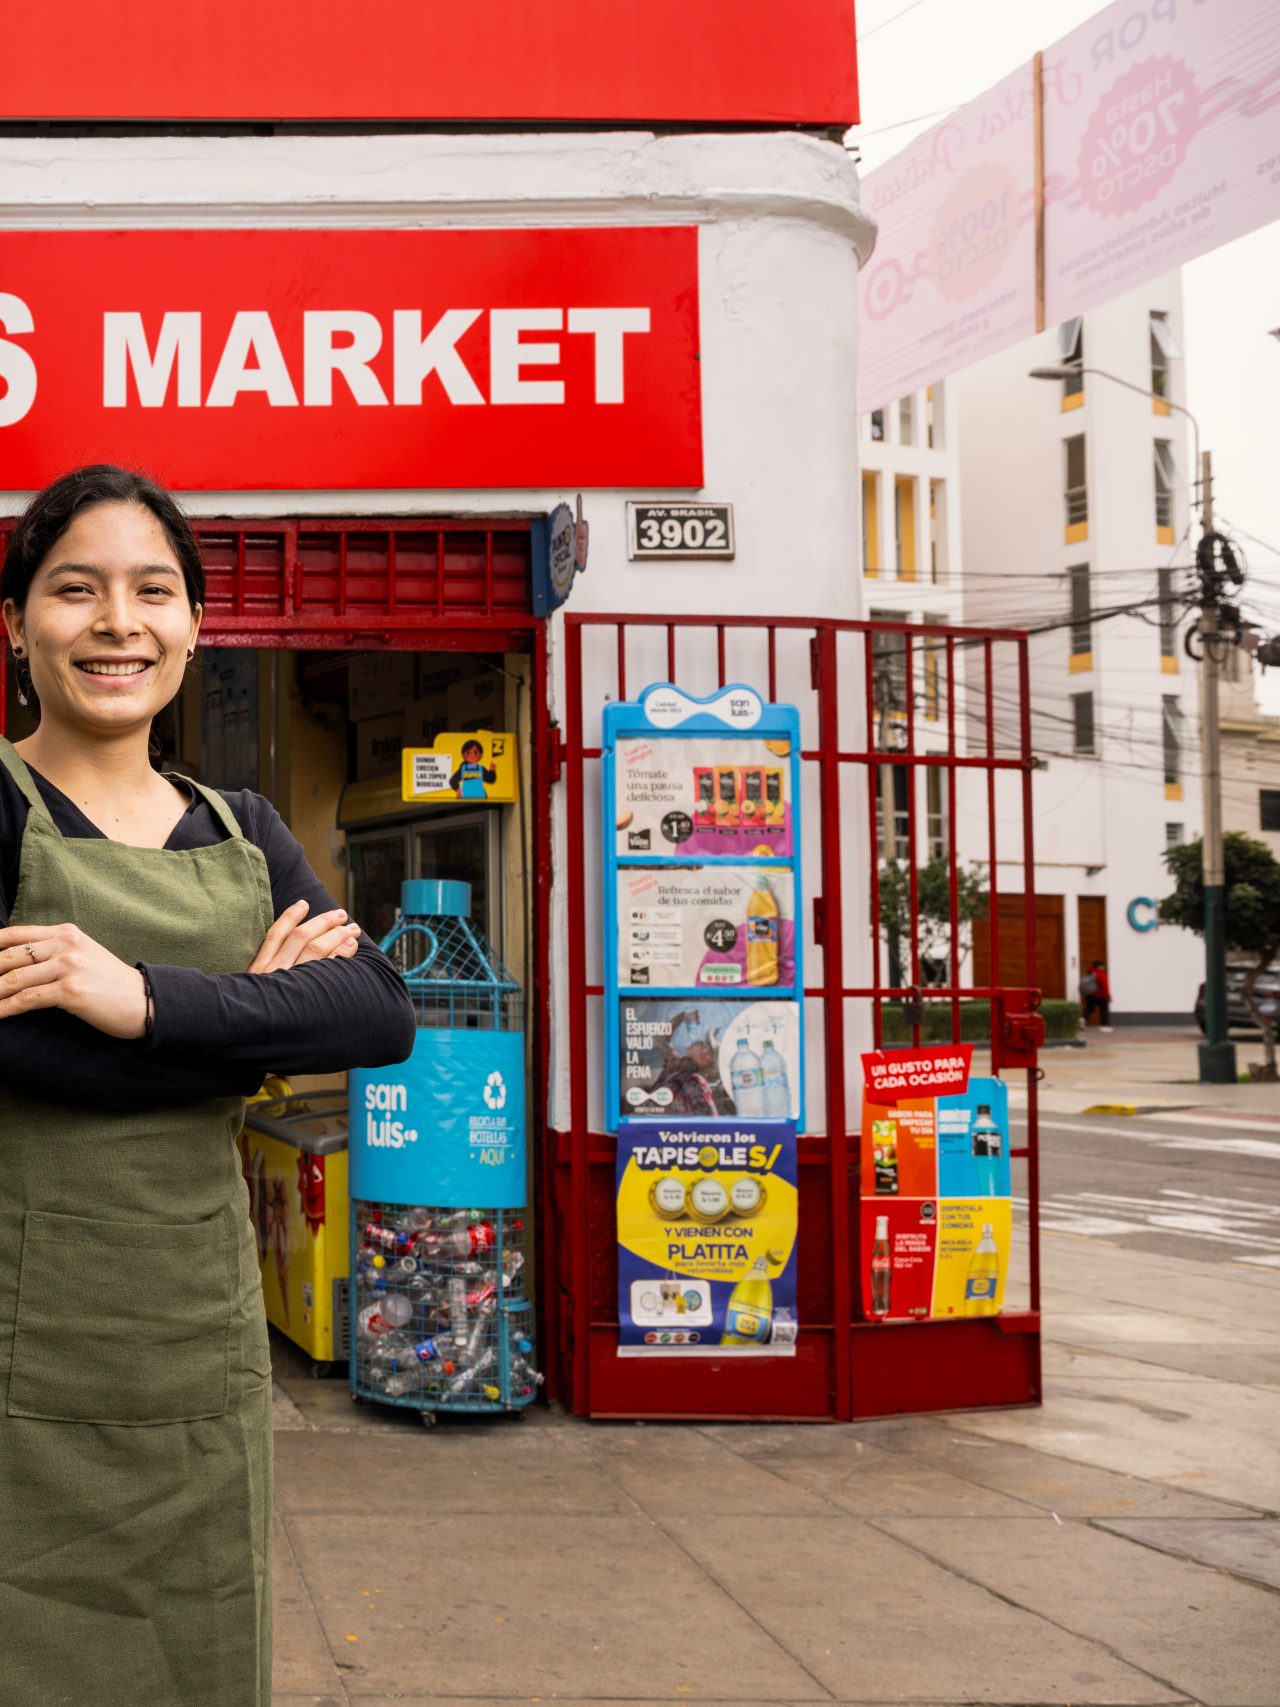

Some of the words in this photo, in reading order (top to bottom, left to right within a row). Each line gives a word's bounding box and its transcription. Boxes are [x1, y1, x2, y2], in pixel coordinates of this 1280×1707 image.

[103, 307, 651, 408] MARKET
[670, 509, 716, 517] BRASIL
[639, 519, 726, 549] 3902
[626, 769, 668, 779] Tómate
[627, 783, 648, 791] una
[650, 783, 683, 792] pausa
[626, 791, 675, 801] deliciosa
[658, 886, 700, 895] Refresca
[703, 886, 713, 895] el
[714, 886, 741, 895] sabor
[658, 896, 671, 905] de
[673, 897, 688, 905] tus
[691, 896, 733, 905] comidas
[626, 1008, 638, 1021] EL
[626, 1022, 672, 1036] ESFUERZO
[626, 1051, 639, 1064] LA
[626, 1066, 652, 1079] PENA
[871, 1065, 887, 1076] UN
[888, 1060, 932, 1074] GUSTO
[934, 1057, 965, 1071] PARA
[874, 1077, 907, 1089] CADA
[909, 1068, 963, 1086] OCASIÓN
[365, 1083, 407, 1112] san
[367, 1112, 404, 1149] luis
[470, 1130, 507, 1143] BOTELLAS
[659, 1131, 731, 1143] Volvieron
[734, 1131, 757, 1143] los
[479, 1147, 505, 1165] AQUÍ
[664, 1228, 672, 1237] Y
[674, 1228, 721, 1237] VIENEN
[723, 1227, 753, 1237] CON
[668, 1244, 749, 1260] PLATITA
